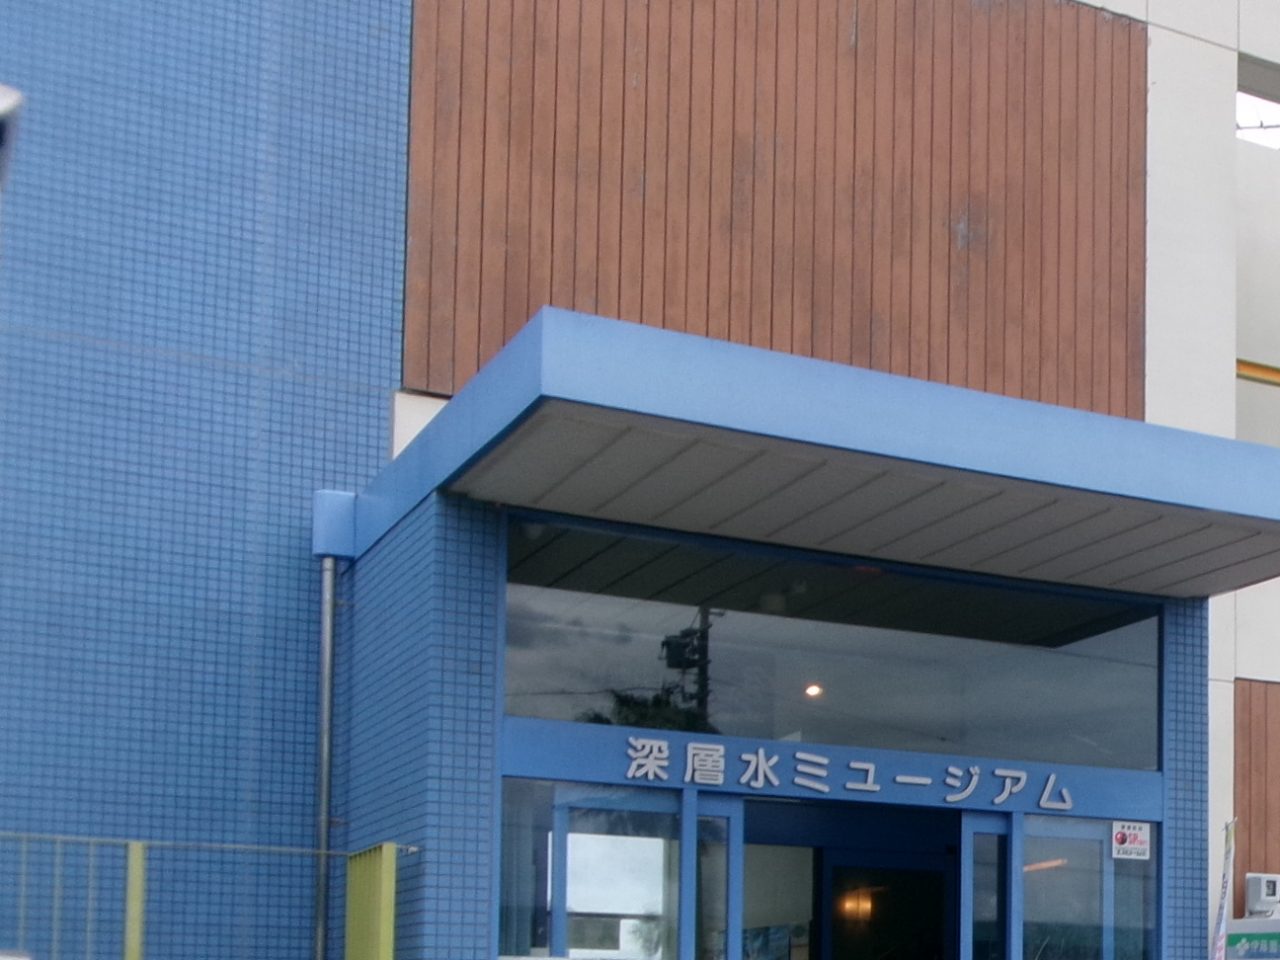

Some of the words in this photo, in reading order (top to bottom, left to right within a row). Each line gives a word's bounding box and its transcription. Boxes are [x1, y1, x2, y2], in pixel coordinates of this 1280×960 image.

[626, 736, 1073, 810] 深層水ミュージアム
